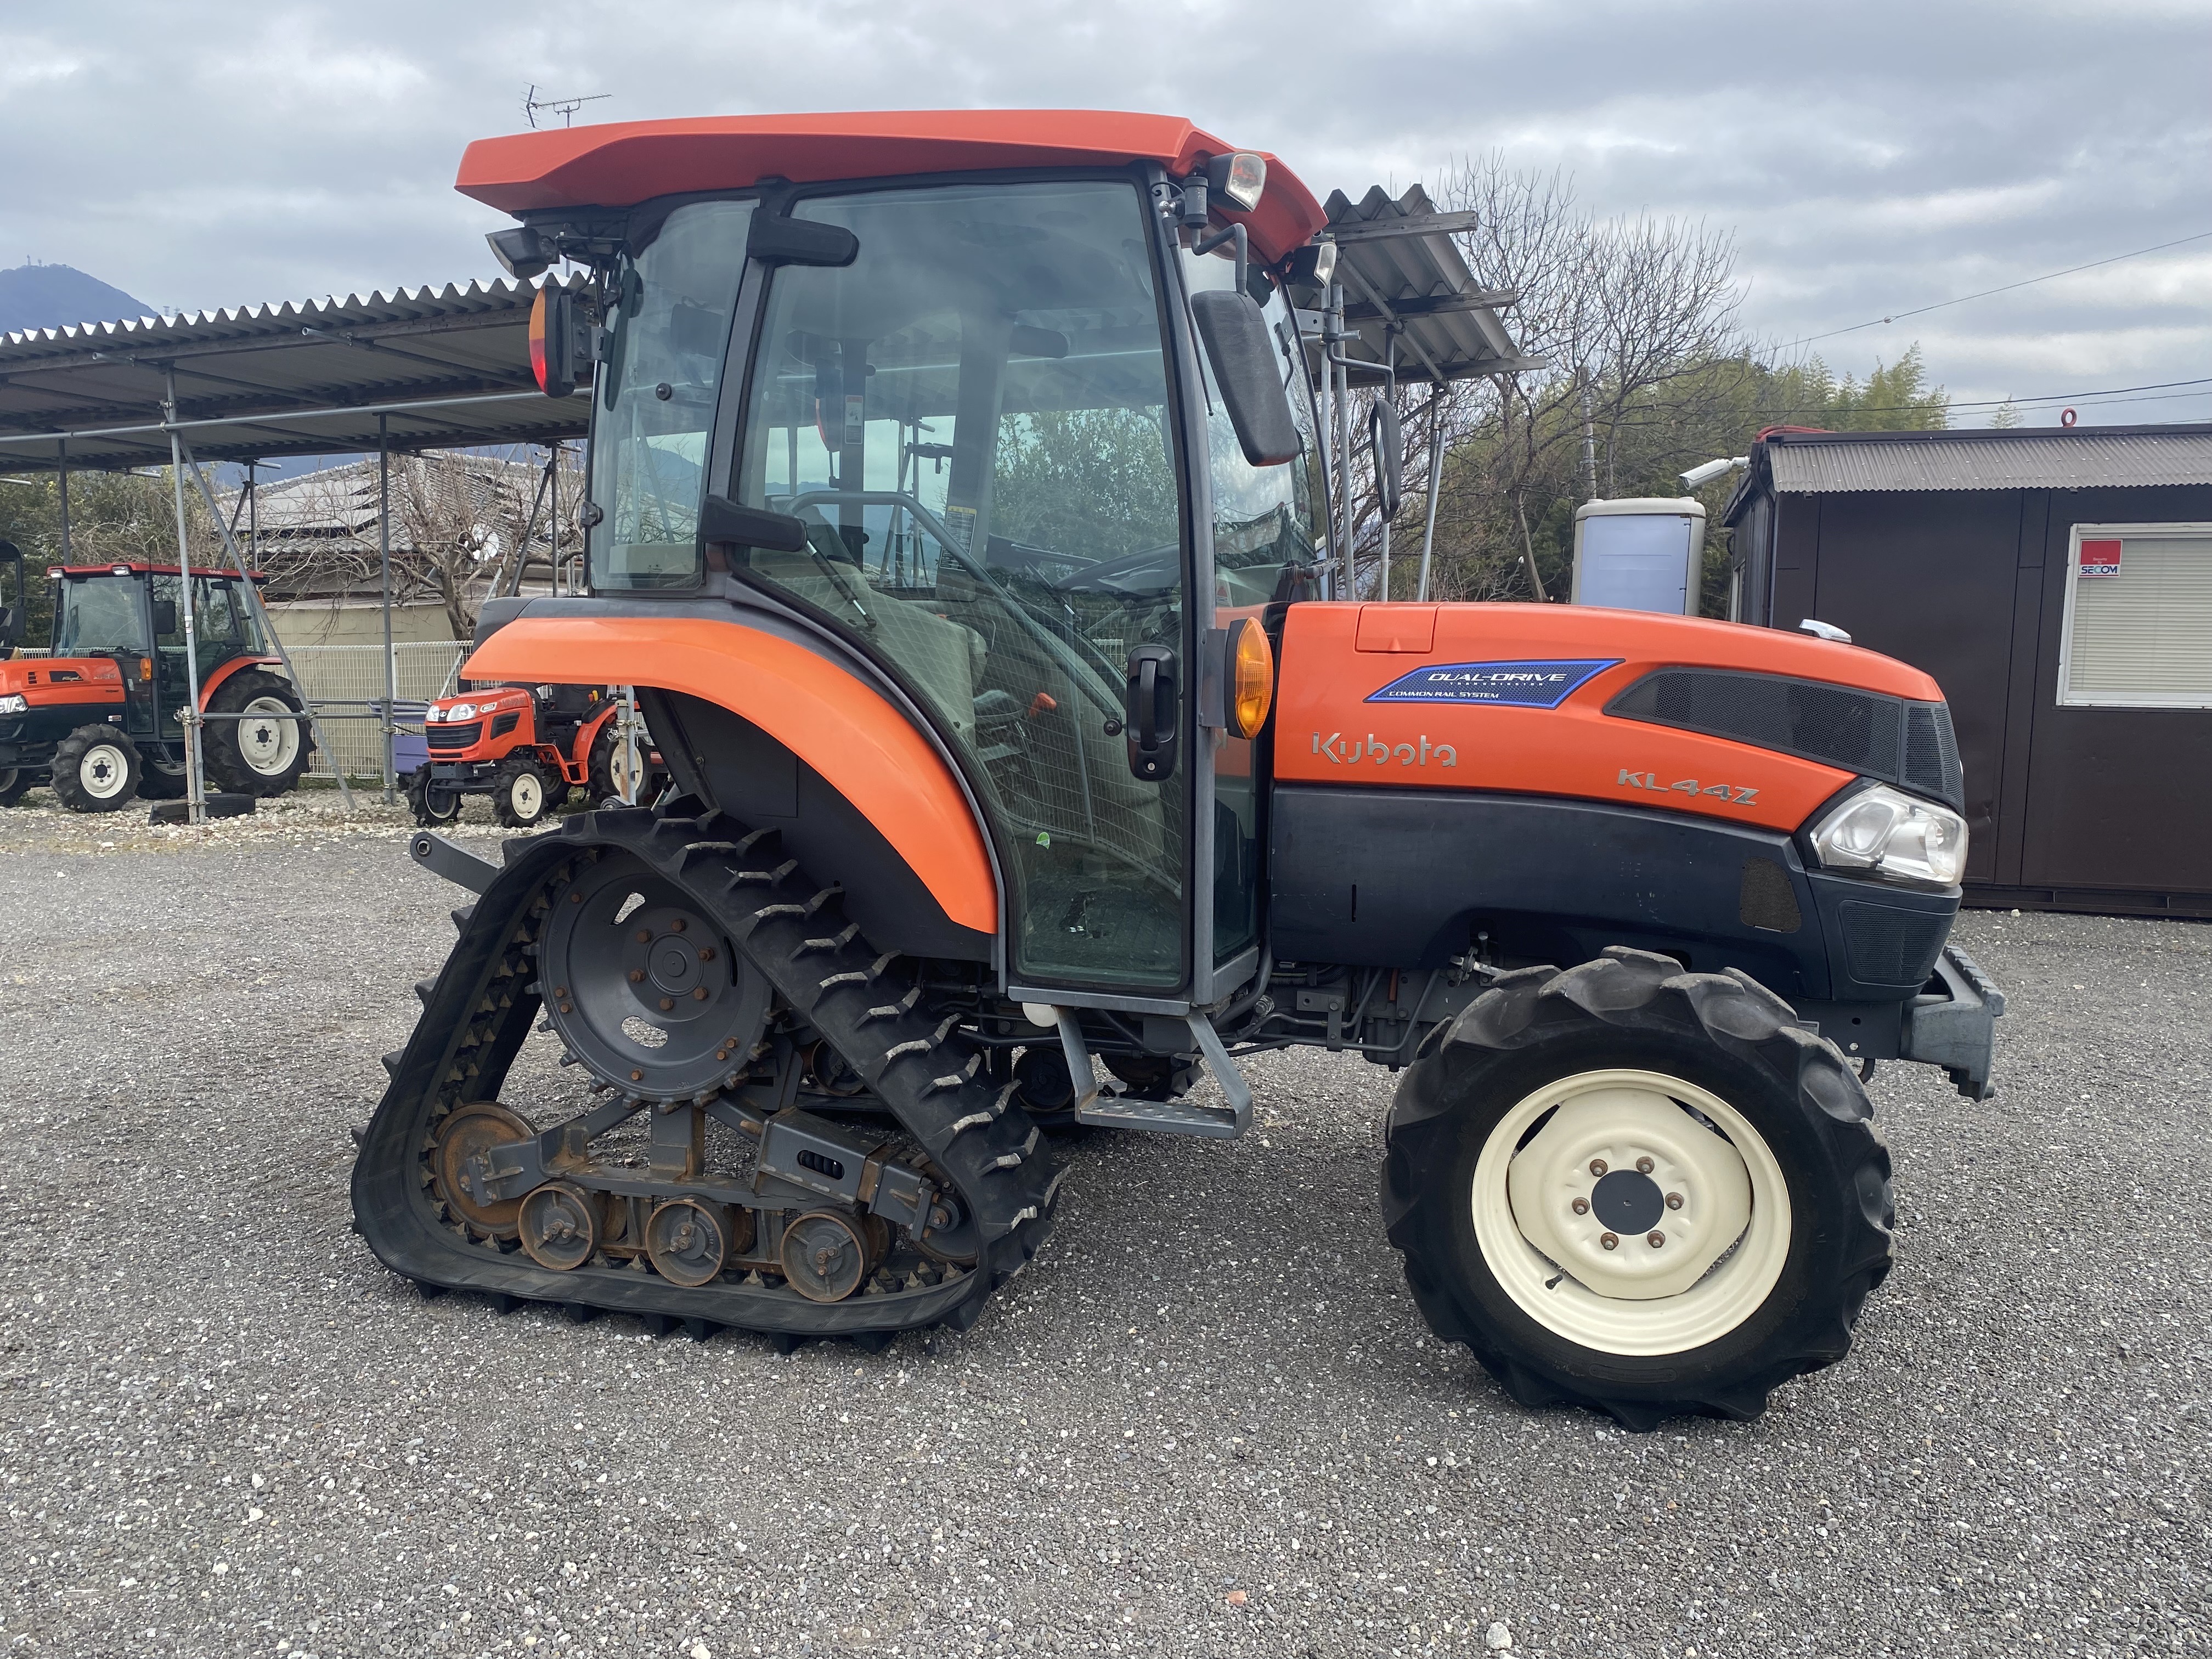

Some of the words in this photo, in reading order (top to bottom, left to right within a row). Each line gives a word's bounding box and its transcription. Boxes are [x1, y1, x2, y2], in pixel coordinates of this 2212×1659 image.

[2081, 566, 2118, 574] SECOM
[1427, 673, 1568, 682] DUAL-DRIVE
[1312, 732, 1457, 767] Kubota
[1617, 769, 1760, 806] KL44Z
